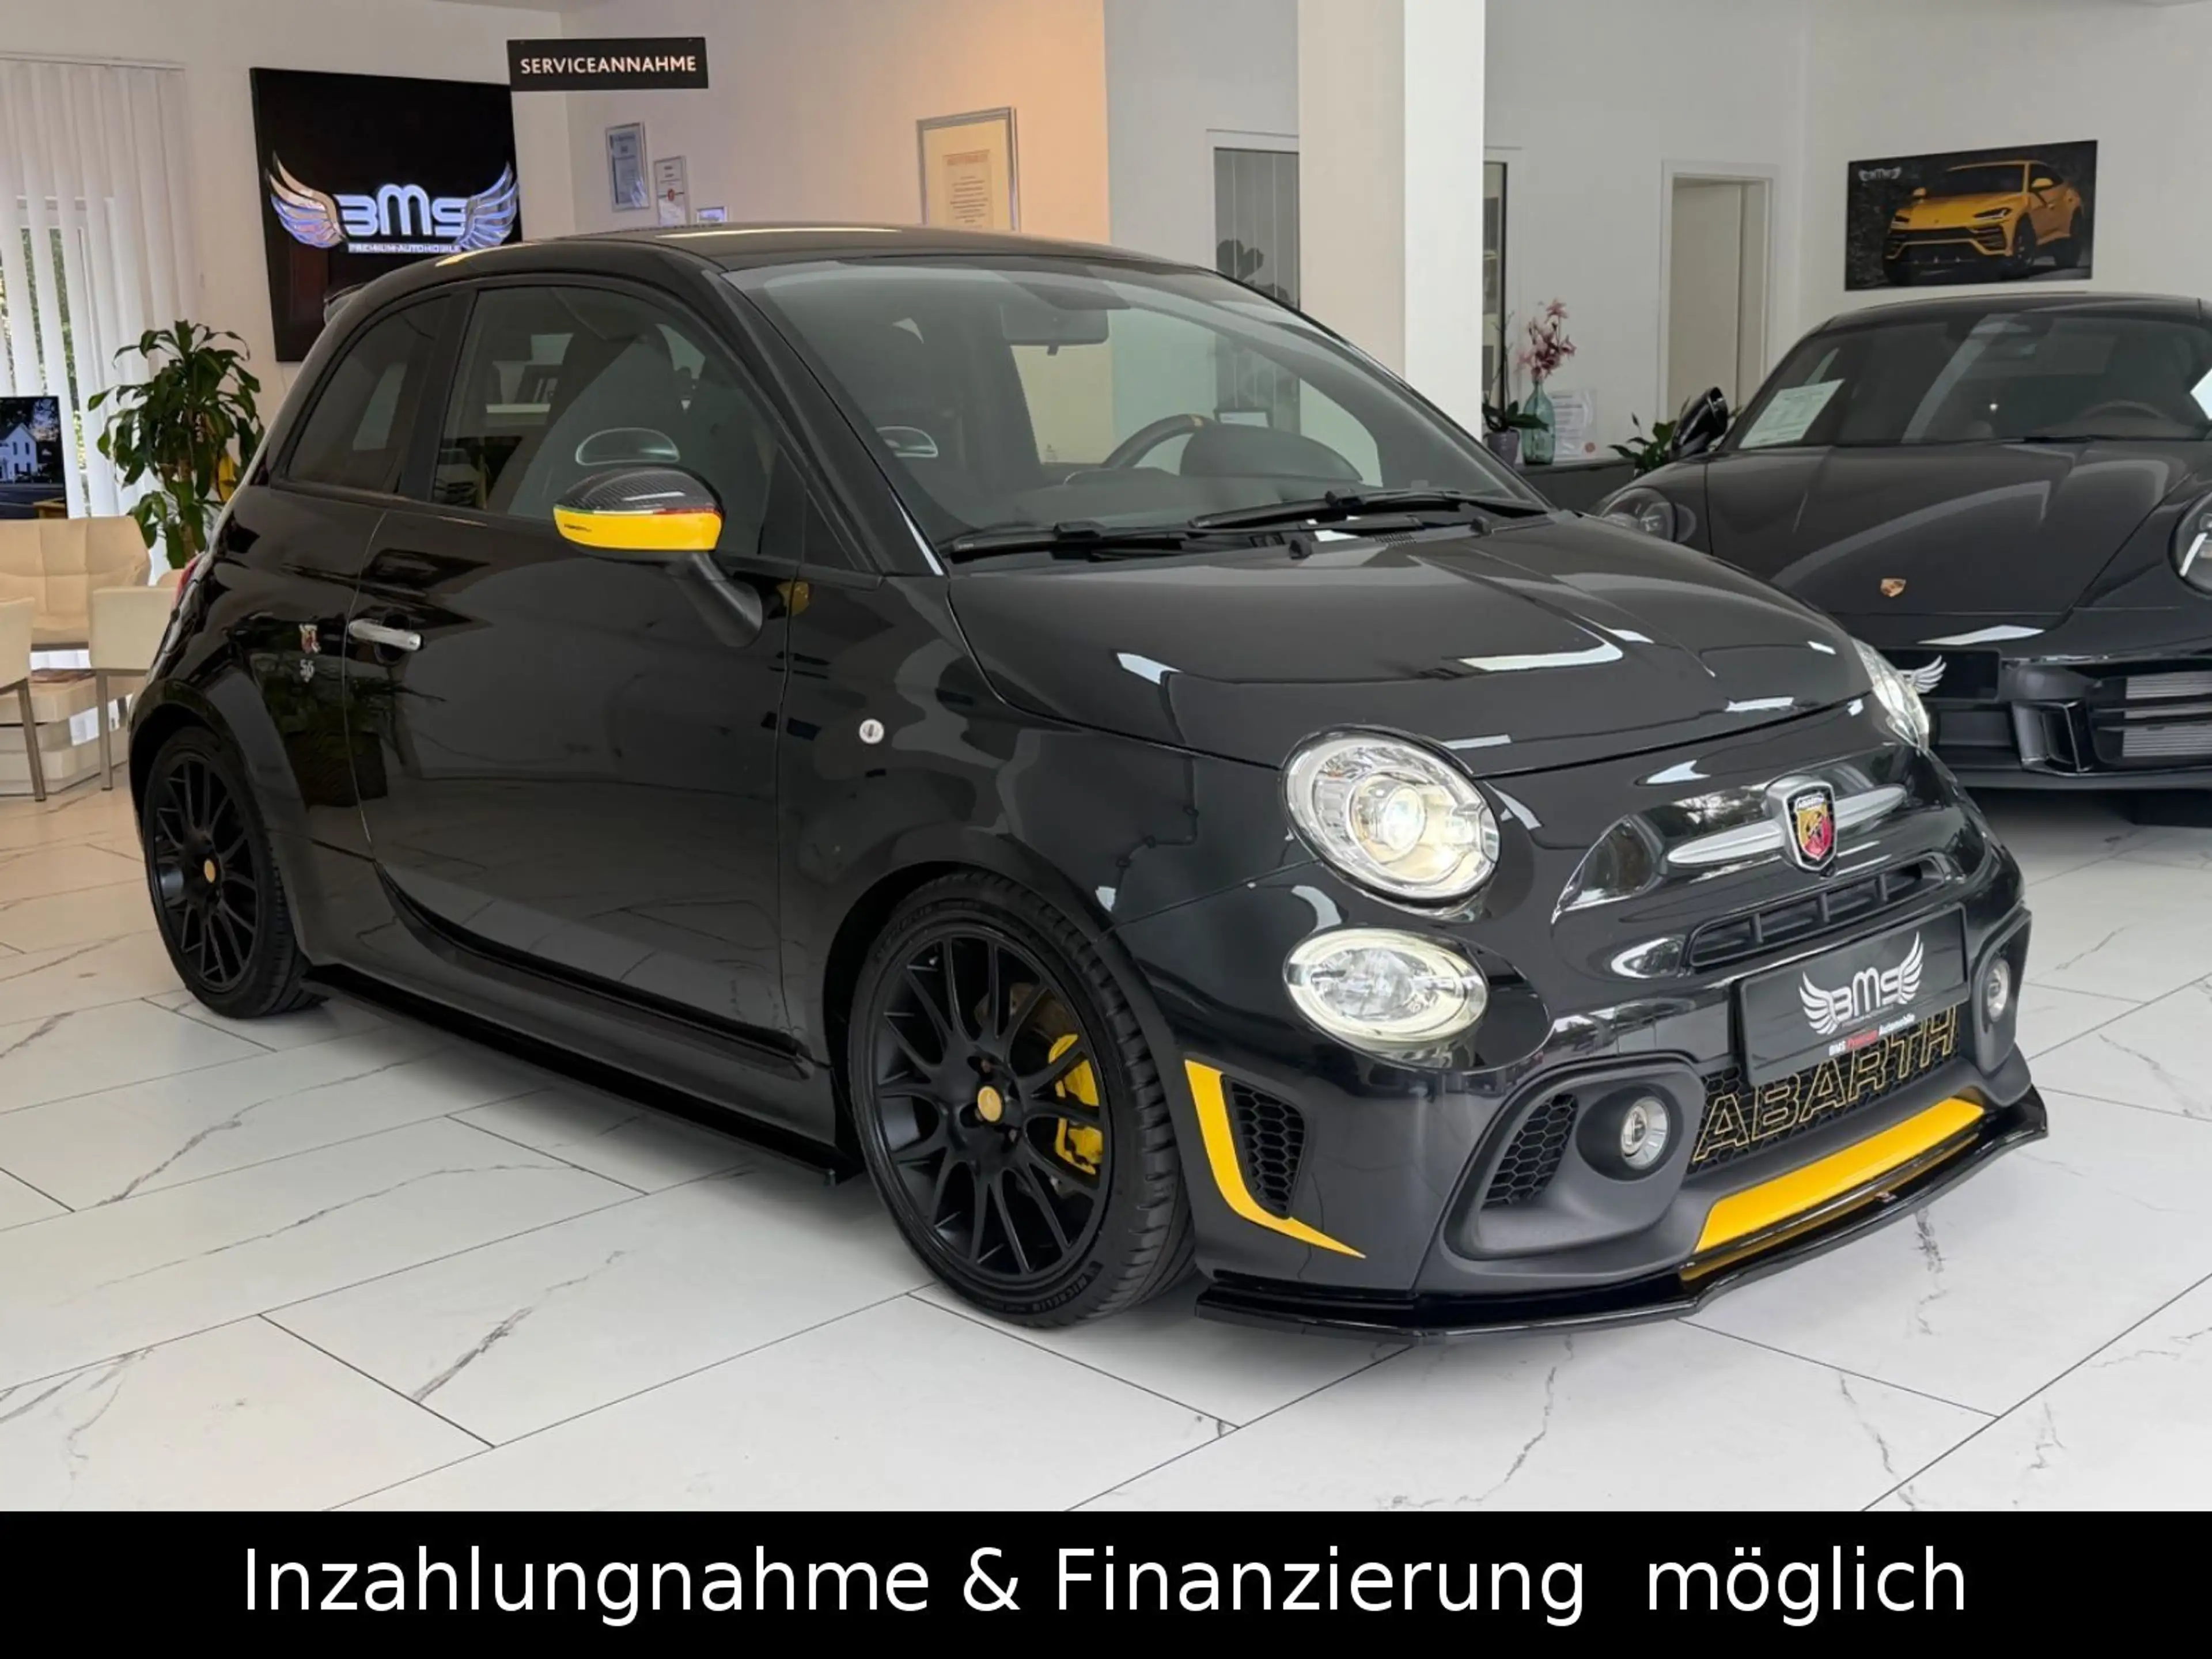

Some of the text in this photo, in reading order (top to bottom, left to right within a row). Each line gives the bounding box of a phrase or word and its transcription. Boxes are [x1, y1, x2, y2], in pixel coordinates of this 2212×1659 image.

[520, 55, 697, 75] SERVICEANNAHME
[332, 183, 468, 237] BMS
[1831, 966, 1902, 1022] BMS
[1692, 1004, 1959, 1163] ABARTH
